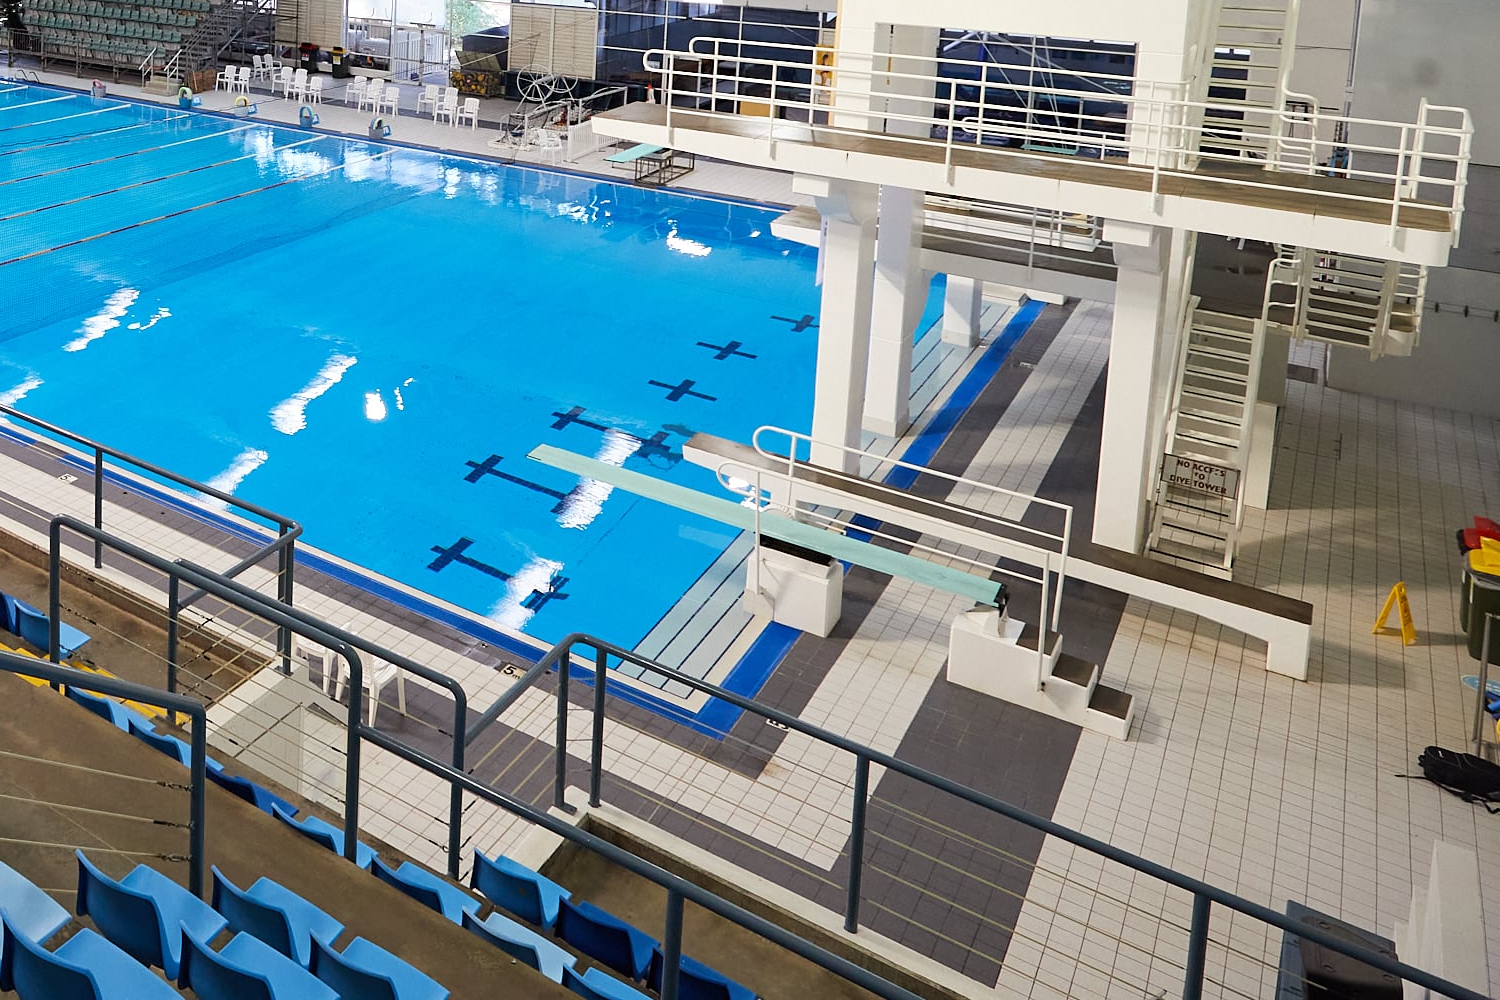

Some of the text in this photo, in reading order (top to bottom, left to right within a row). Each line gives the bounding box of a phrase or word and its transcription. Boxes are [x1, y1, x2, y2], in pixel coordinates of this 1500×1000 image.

[1177, 460, 1190, 468] NO
[1169, 474, 1227, 495] DIVE TOWER
